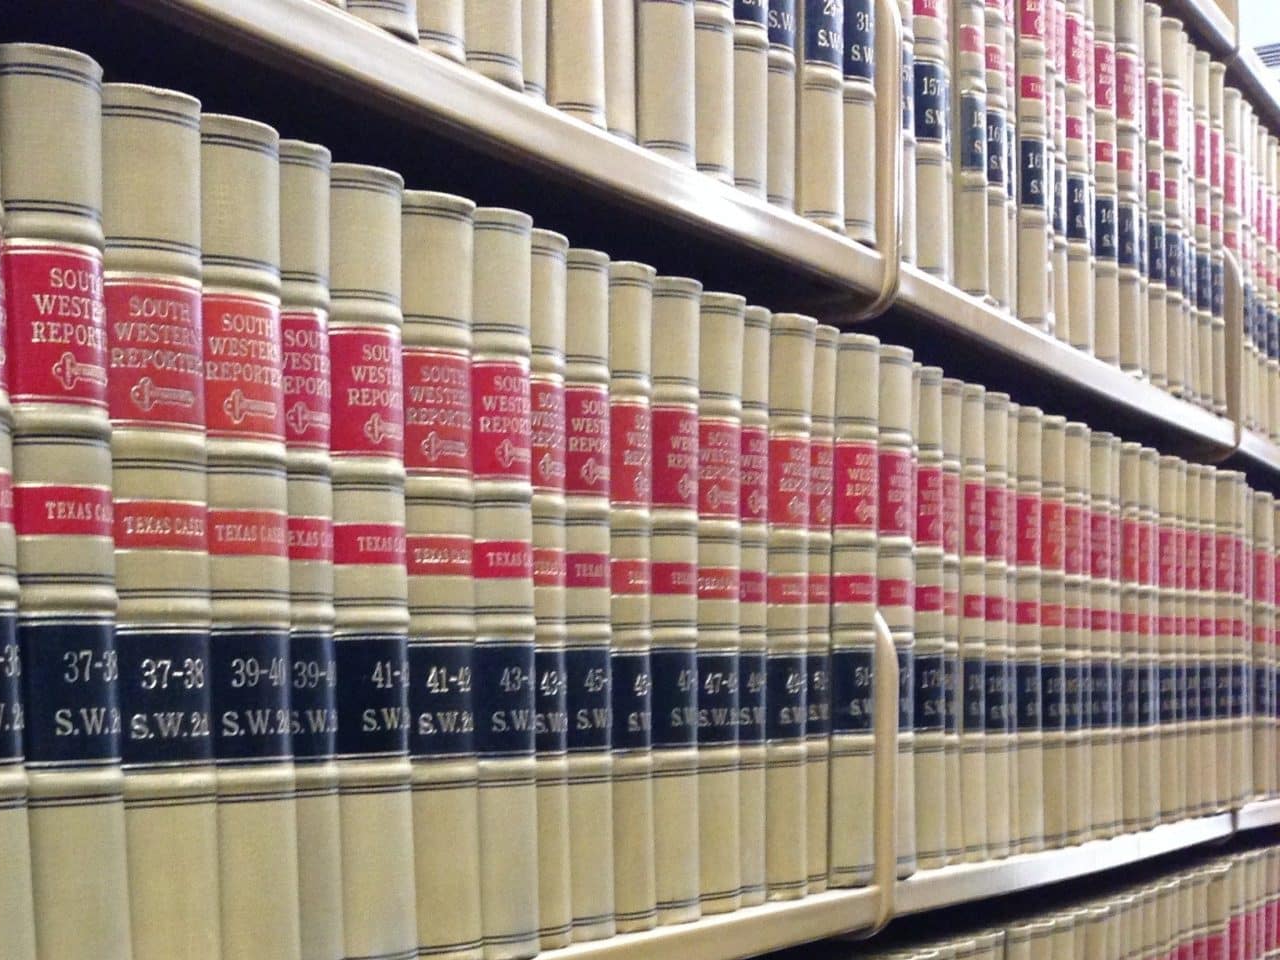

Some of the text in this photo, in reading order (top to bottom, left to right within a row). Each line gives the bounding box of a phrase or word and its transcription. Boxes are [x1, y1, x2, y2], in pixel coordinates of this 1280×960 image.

[128, 296, 192, 323] SOUTH
[221, 312, 275, 338] SOUTH
[45, 501, 91, 521] TEXAS
[123, 515, 170, 536] TEXAS
[215, 524, 257, 544] TEXAS
[141, 658, 204, 690] 37-38
